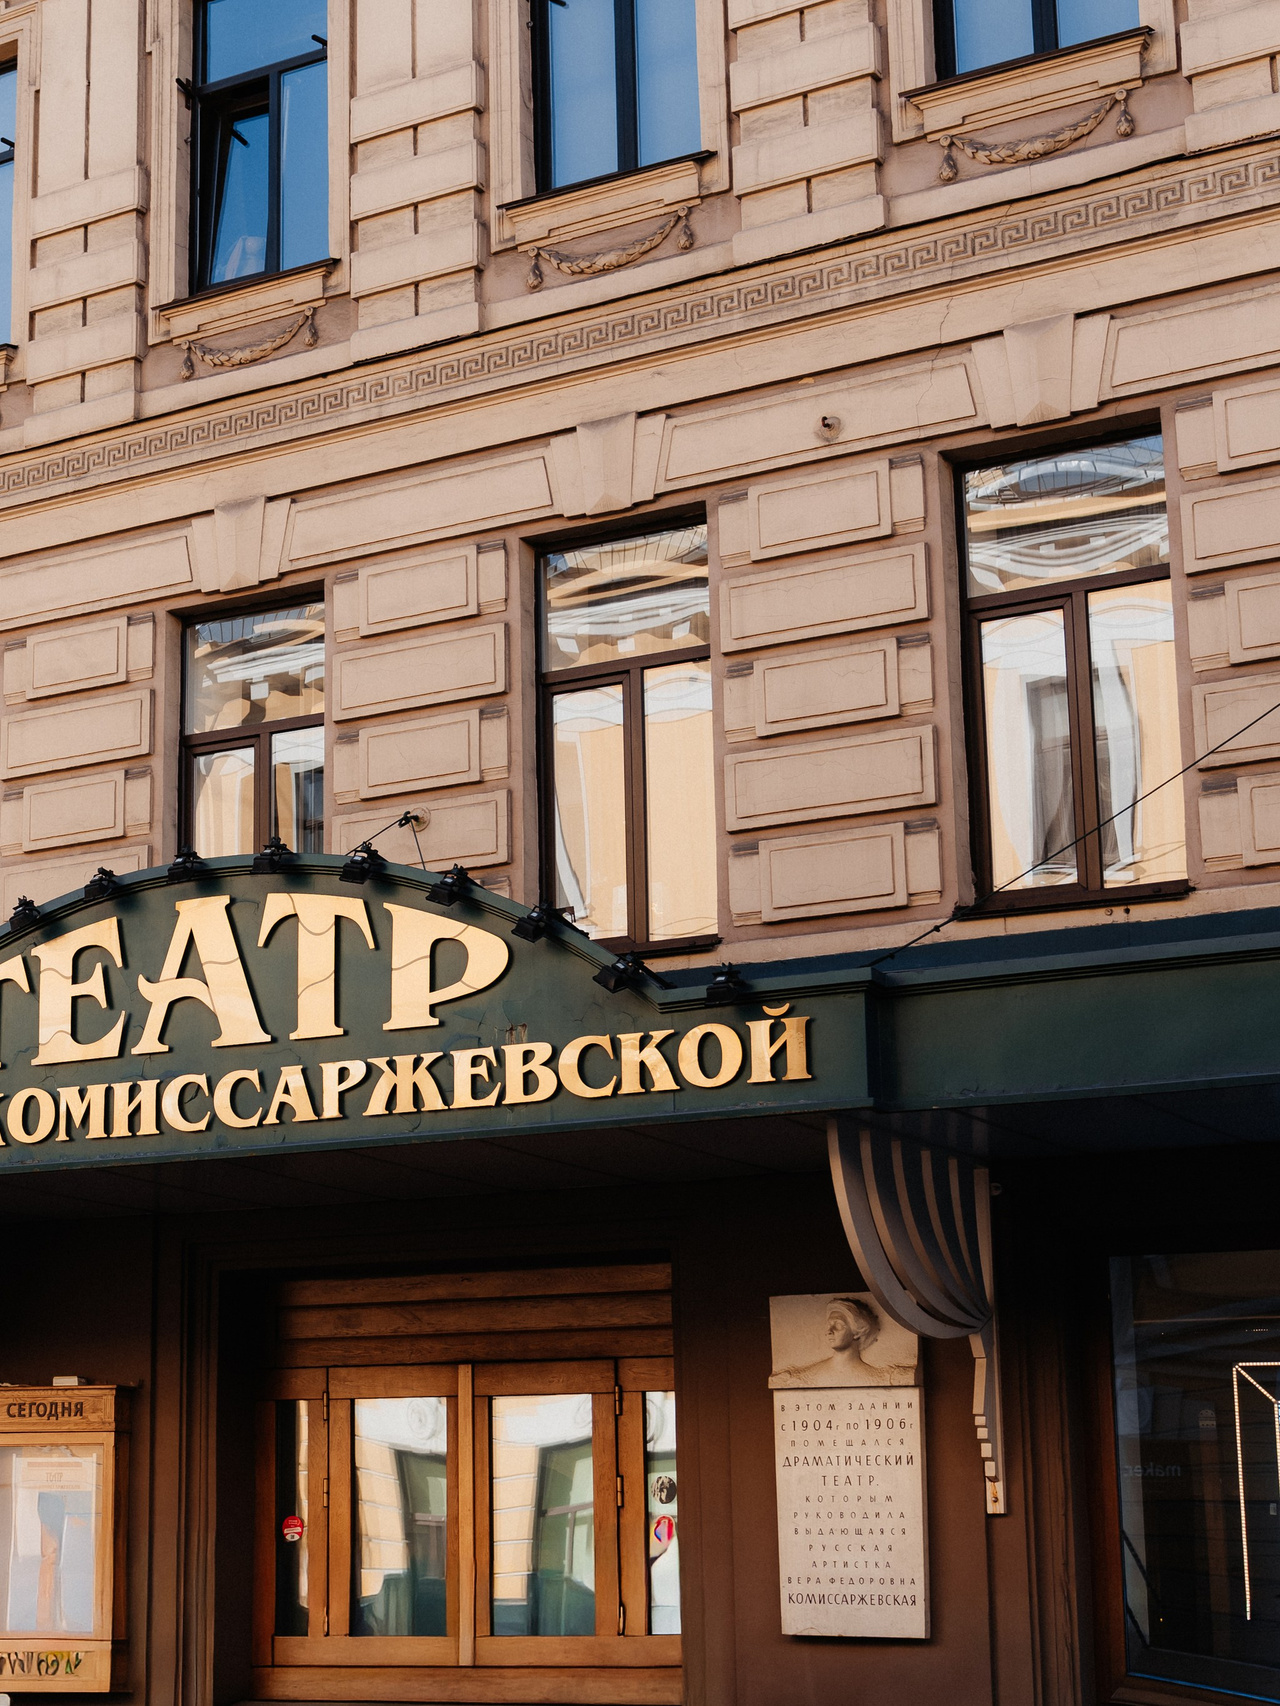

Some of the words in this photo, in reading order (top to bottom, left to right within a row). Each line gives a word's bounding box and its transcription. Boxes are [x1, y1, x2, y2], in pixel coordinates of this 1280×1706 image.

[6, 1401, 84, 1421] СЕГОДНЯ
[781, 1404, 786, 1412] В
[795, 1403, 836, 1412] ЭТОМ
[847, 1402, 913, 1411] ЗДАНИИ
[790, 1438, 905, 1448] ПОМЕЩАЛСЯ
[782, 1452, 914, 1468] ДРАМАТИЧЕСКИЙ
[805, 1495, 893, 1503] КОТОРЫМ
[793, 1511, 905, 1519] РУКОВОДИЛА
[794, 1527, 906, 1536] ВЫДАЮЩАЯСЯ
[808, 1544, 893, 1552] РУССКАЯ
[811, 1560, 891, 1569] АРТИСТКА
[787, 1576, 821, 1585] ВЕРА
[828, 1577, 916, 1586] ФЕДОРОВНА
[788, 1592, 917, 1607] КОМИССАРЖЕВСКАЯ
